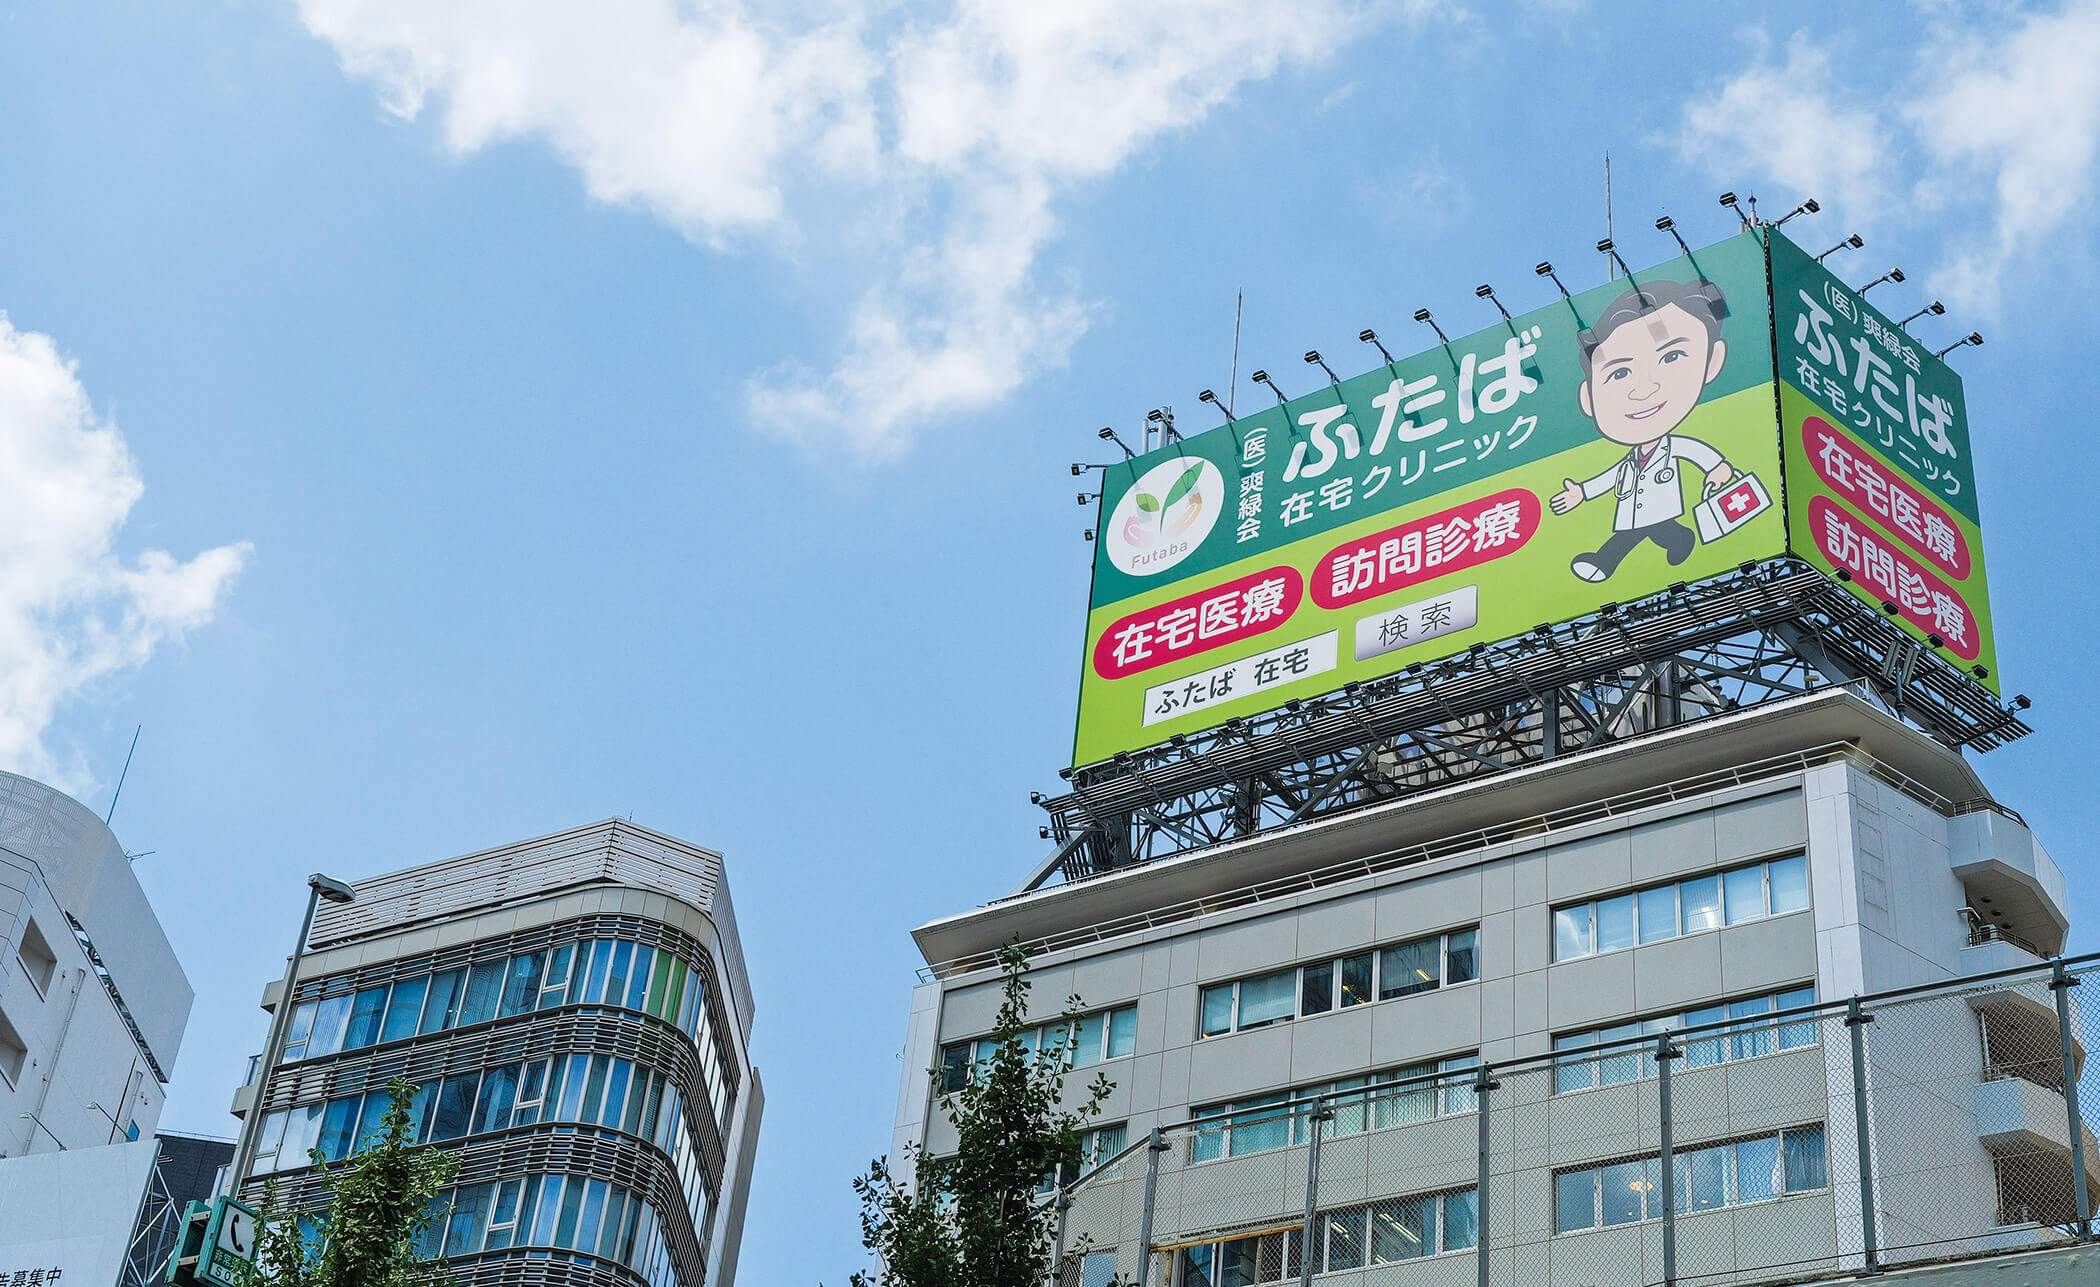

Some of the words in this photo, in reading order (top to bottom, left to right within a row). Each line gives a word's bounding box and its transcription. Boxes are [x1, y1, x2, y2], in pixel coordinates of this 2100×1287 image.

[1282, 325, 1541, 482] ふたば
[1794, 289, 1957, 459] ふたば
[1796, 356, 1960, 495] 在宅クリニック
[1279, 415, 1538, 527] 在宅クリニック
[1818, 432, 1958, 568] 在宅医療
[1131, 540, 1189, 569] Futaba
[1331, 500, 1521, 597] 訪問診療
[1825, 509, 1967, 648] 訪問診療
[1113, 577, 1287, 668] 在宅医療
[1378, 601, 1452, 647] 検索
[1154, 667, 1239, 715] ふたば
[1254, 648, 1309, 687] 在宅
[213, 1248, 249, 1274] 非常
